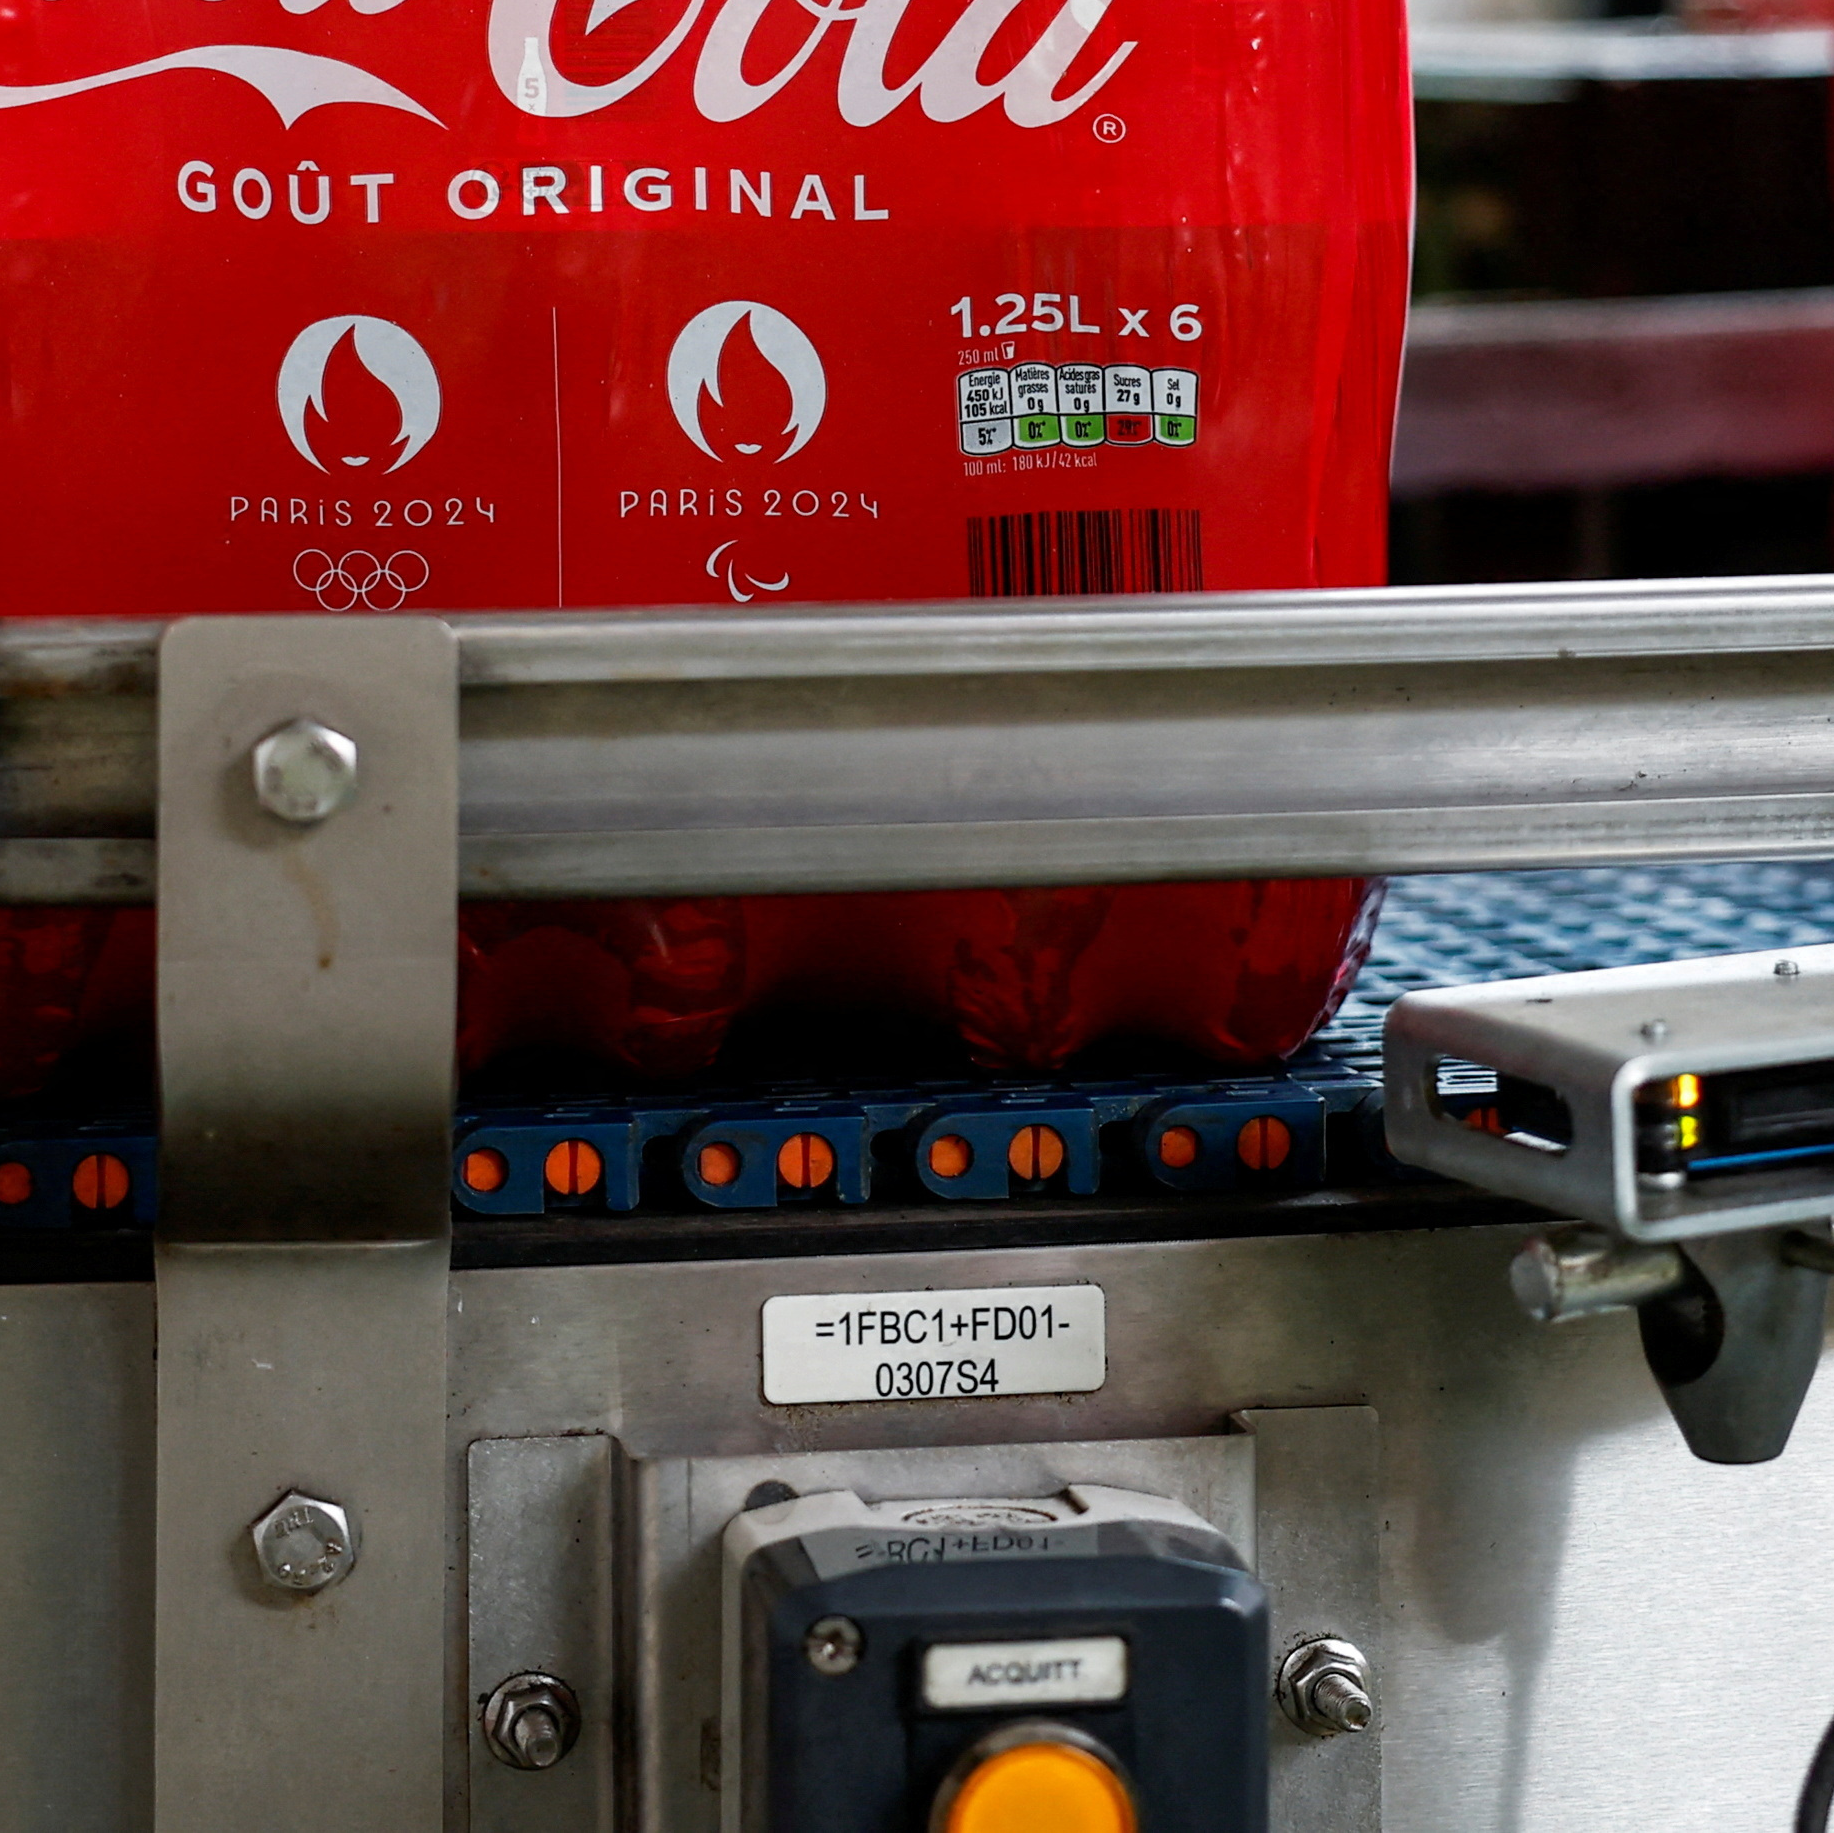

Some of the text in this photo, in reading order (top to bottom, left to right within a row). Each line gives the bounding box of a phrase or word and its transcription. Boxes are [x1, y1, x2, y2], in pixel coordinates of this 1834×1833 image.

[177, 160, 395, 225] GOÛT
[447, 164, 890, 221] ORIGINAL
[950, 292, 1203, 342] 1.25L x 6
[957, 347, 999, 366] 250 ml
[968, 372, 1001, 388] Energie
[1015, 367, 1050, 382] Matières
[1113, 373, 1142, 388] Sucres
[1017, 383, 1049, 398] grasses
[1167, 378, 1180, 391] Sel
[966, 387, 1004, 402] 450 kJ
[1116, 389, 1140, 406] 27 g
[1166, 393, 1182, 408] 0 g
[964, 401, 1008, 418] 105 kcal
[1027, 397, 1044, 412] 0 g
[1073, 397, 1090, 413] 0 g
[963, 460, 983, 477] 100
[1012, 455, 1033, 471] 180
[1074, 452, 1098, 468] kcal
[372, 496, 495, 527] 2024
[763, 489, 878, 519] 2024
[815, 1304, 1070, 1346] =1FBC1+FD01-
[875, 1358, 1000, 1398] 0307S4
